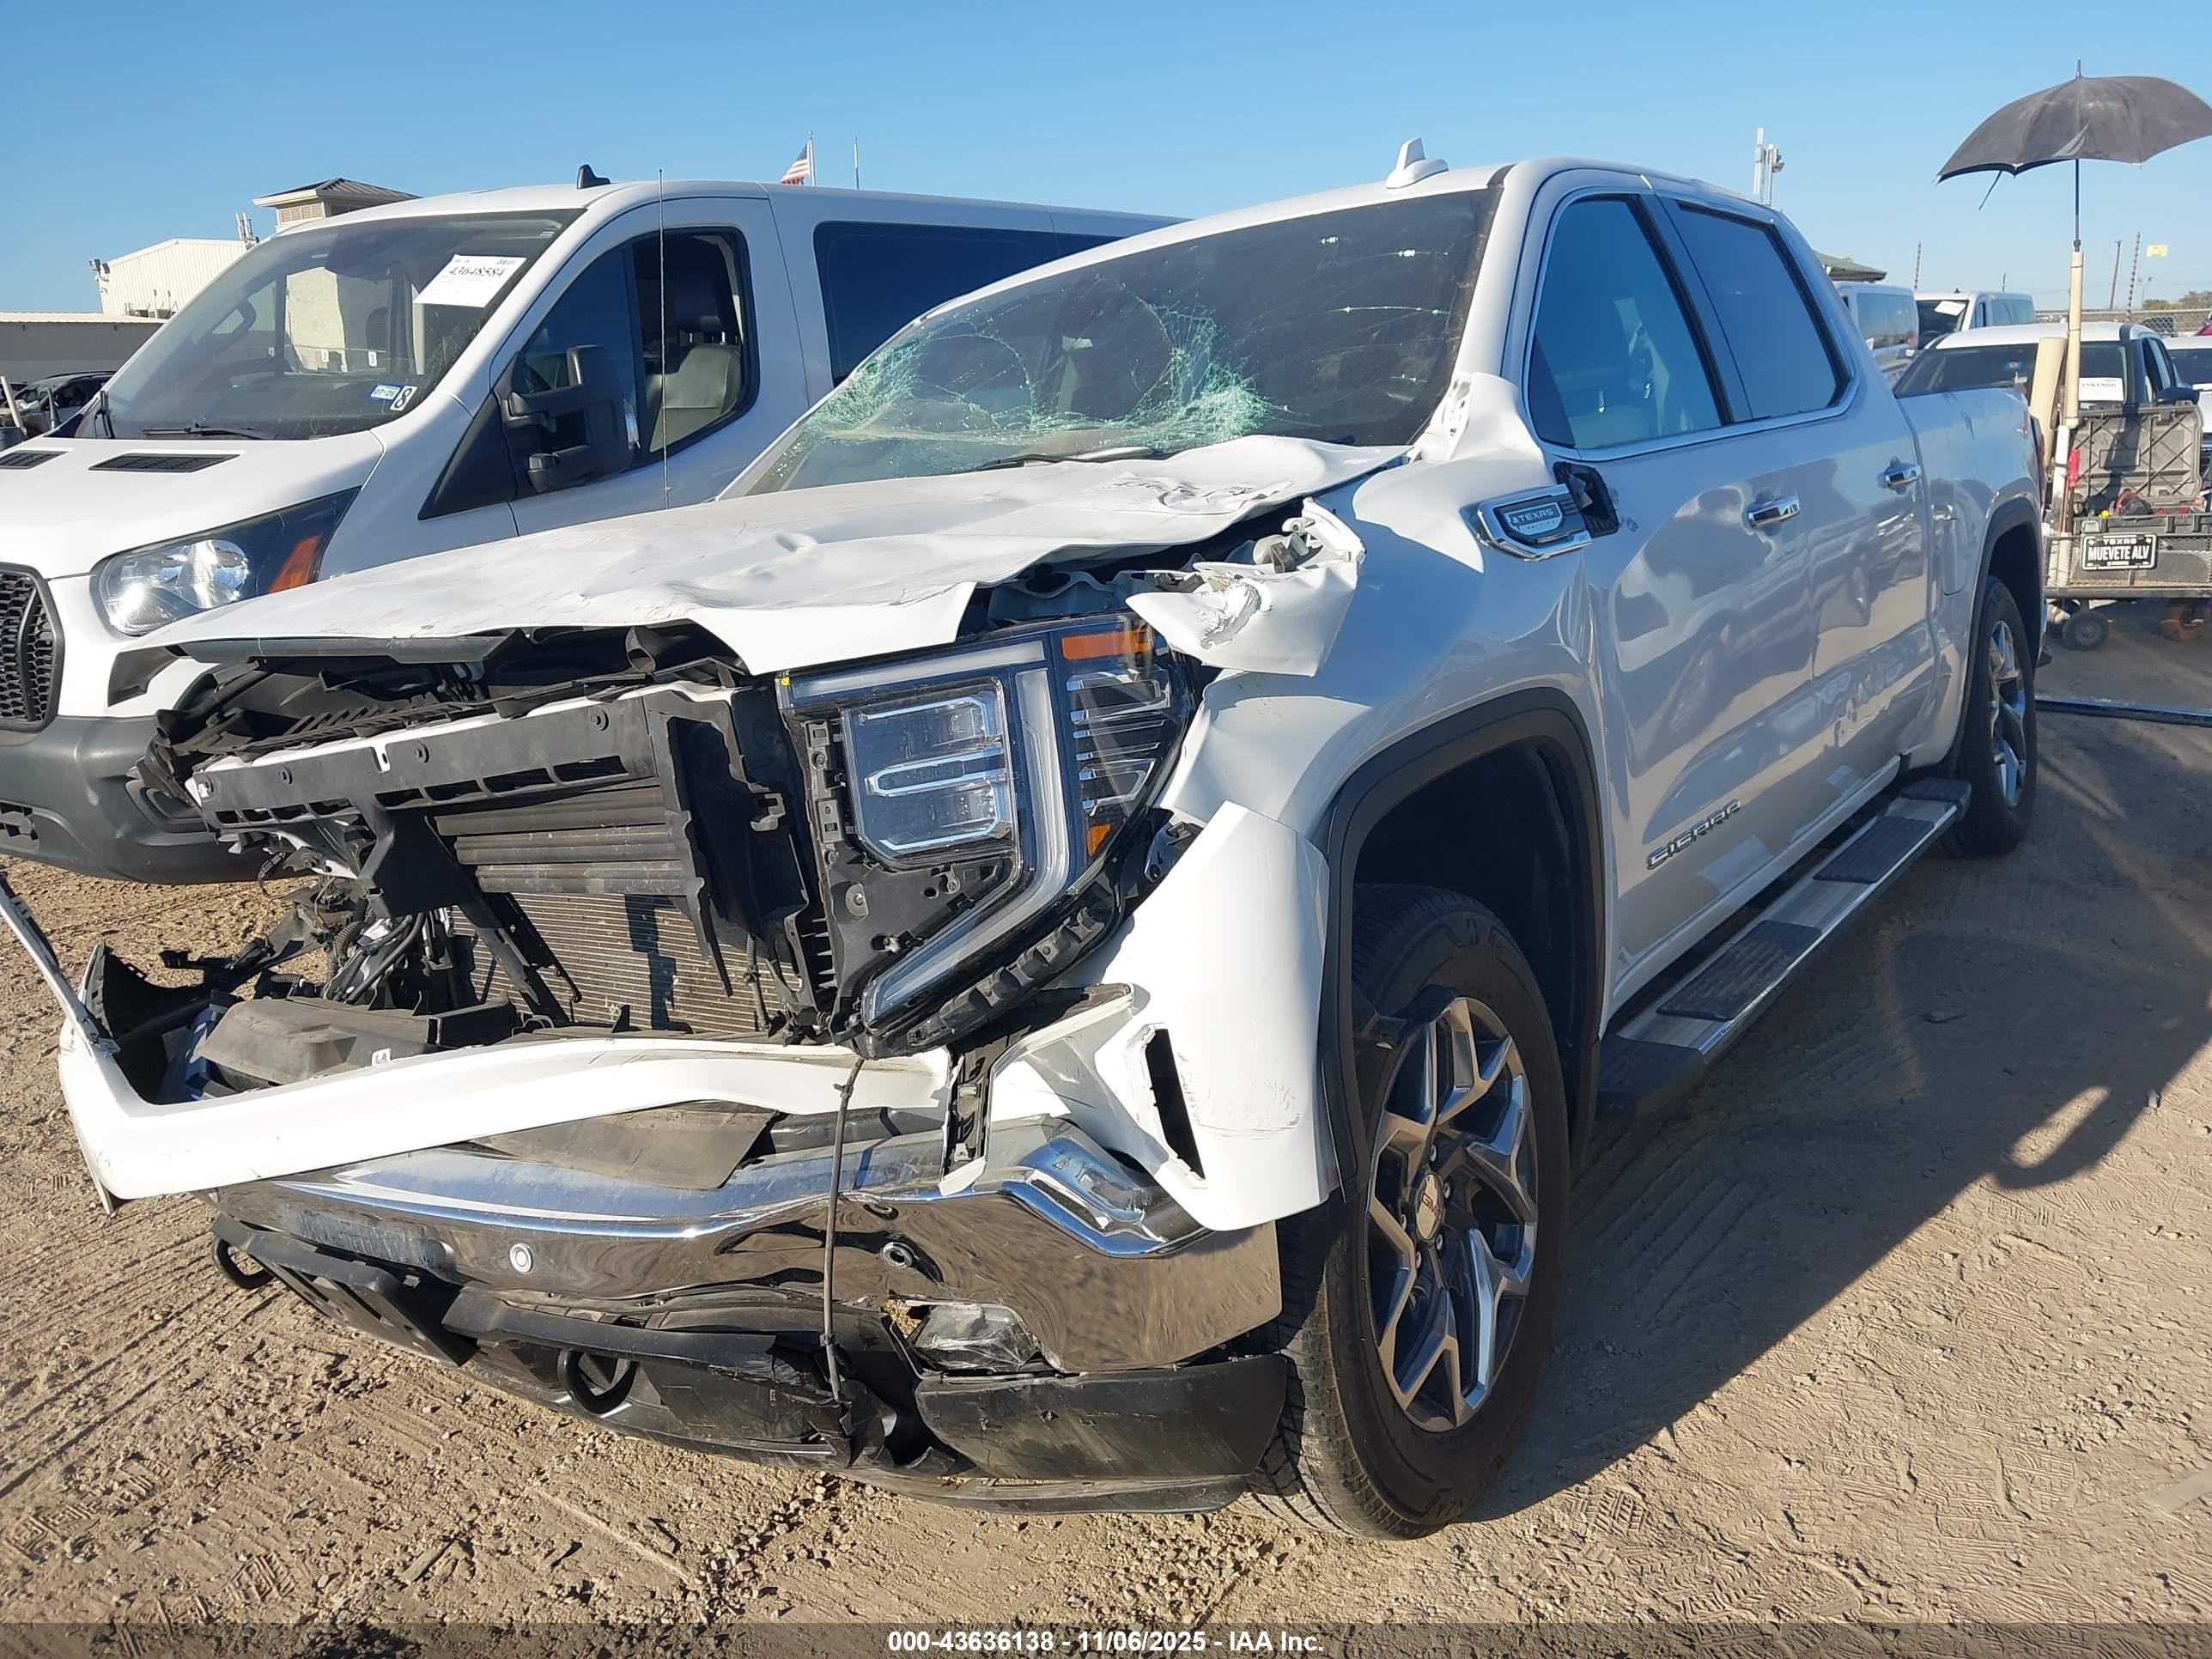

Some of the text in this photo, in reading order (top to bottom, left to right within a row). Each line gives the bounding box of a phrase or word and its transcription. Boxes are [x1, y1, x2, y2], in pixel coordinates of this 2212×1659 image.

[394, 387, 412, 408] 8
[1517, 508, 1553, 522] TEXAS
[2087, 544, 2149, 561] MUEVETE ALV
[1648, 799, 1741, 870] SIERRA
